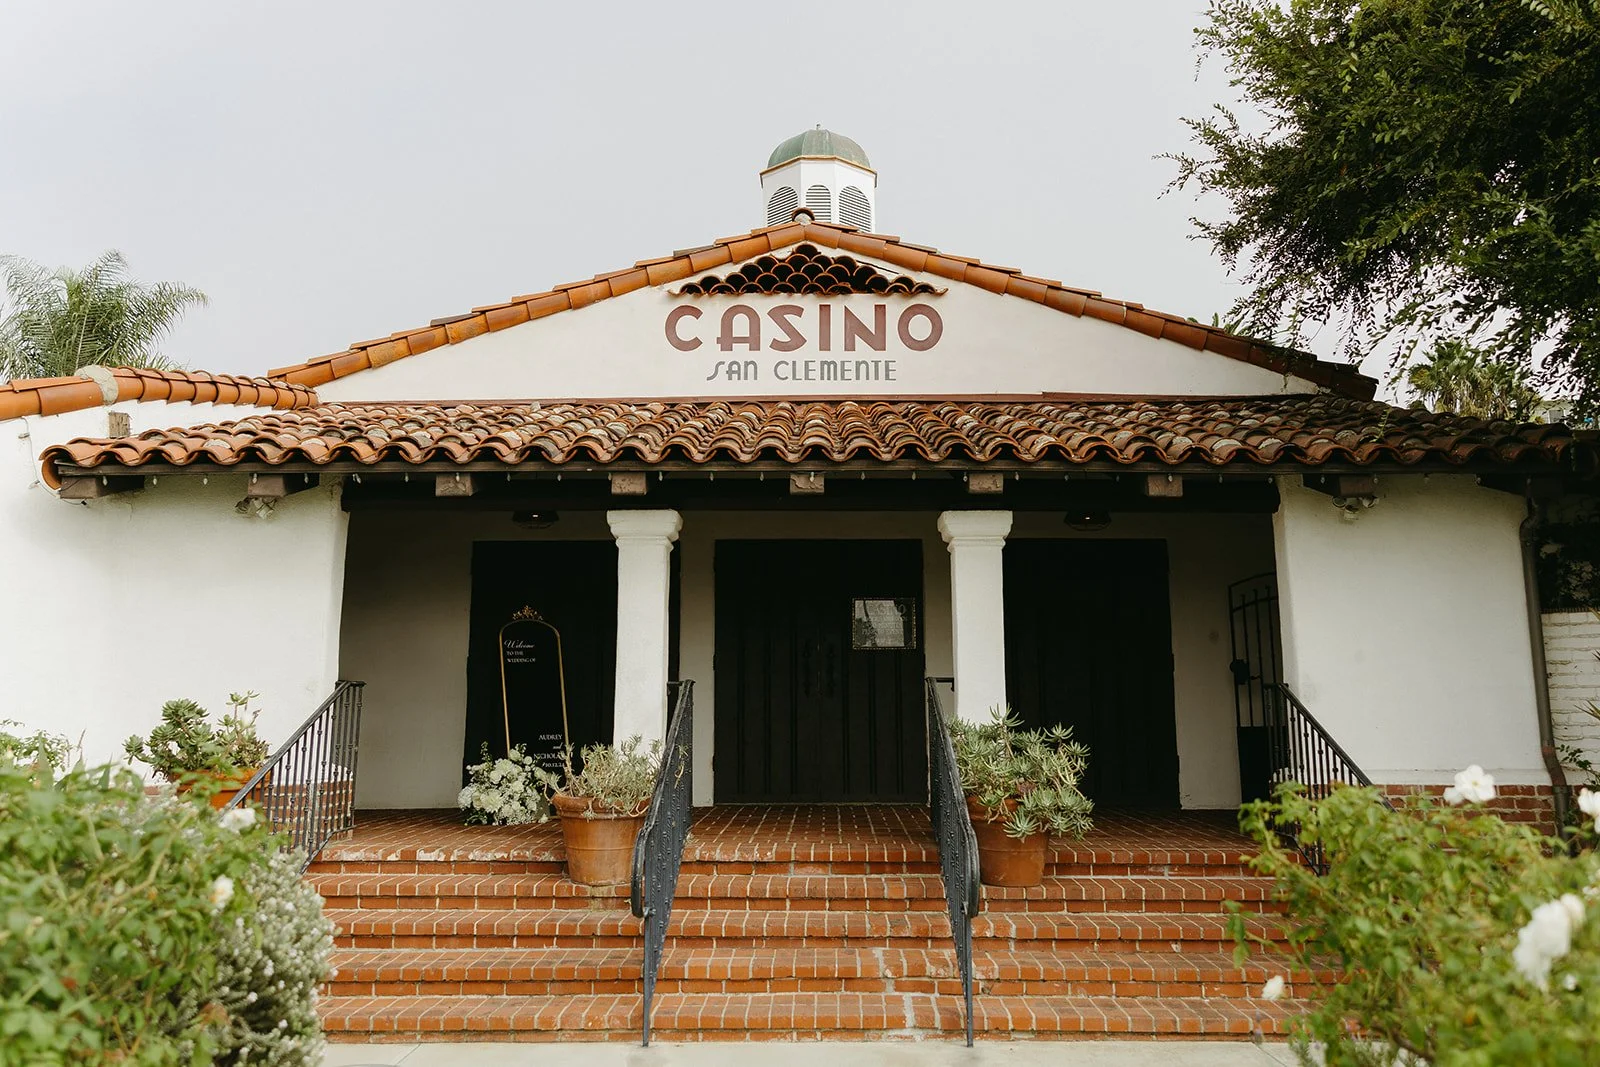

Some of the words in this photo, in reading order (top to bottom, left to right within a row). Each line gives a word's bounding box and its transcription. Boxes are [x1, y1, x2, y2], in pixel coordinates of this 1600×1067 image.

[664, 303, 944, 352] CASINO
[706, 360, 758, 381] SAN
[773, 360, 897, 381] CLEMENTE
[503, 640, 535, 649] Welcome
[533, 752, 561, 760] NCHOL
